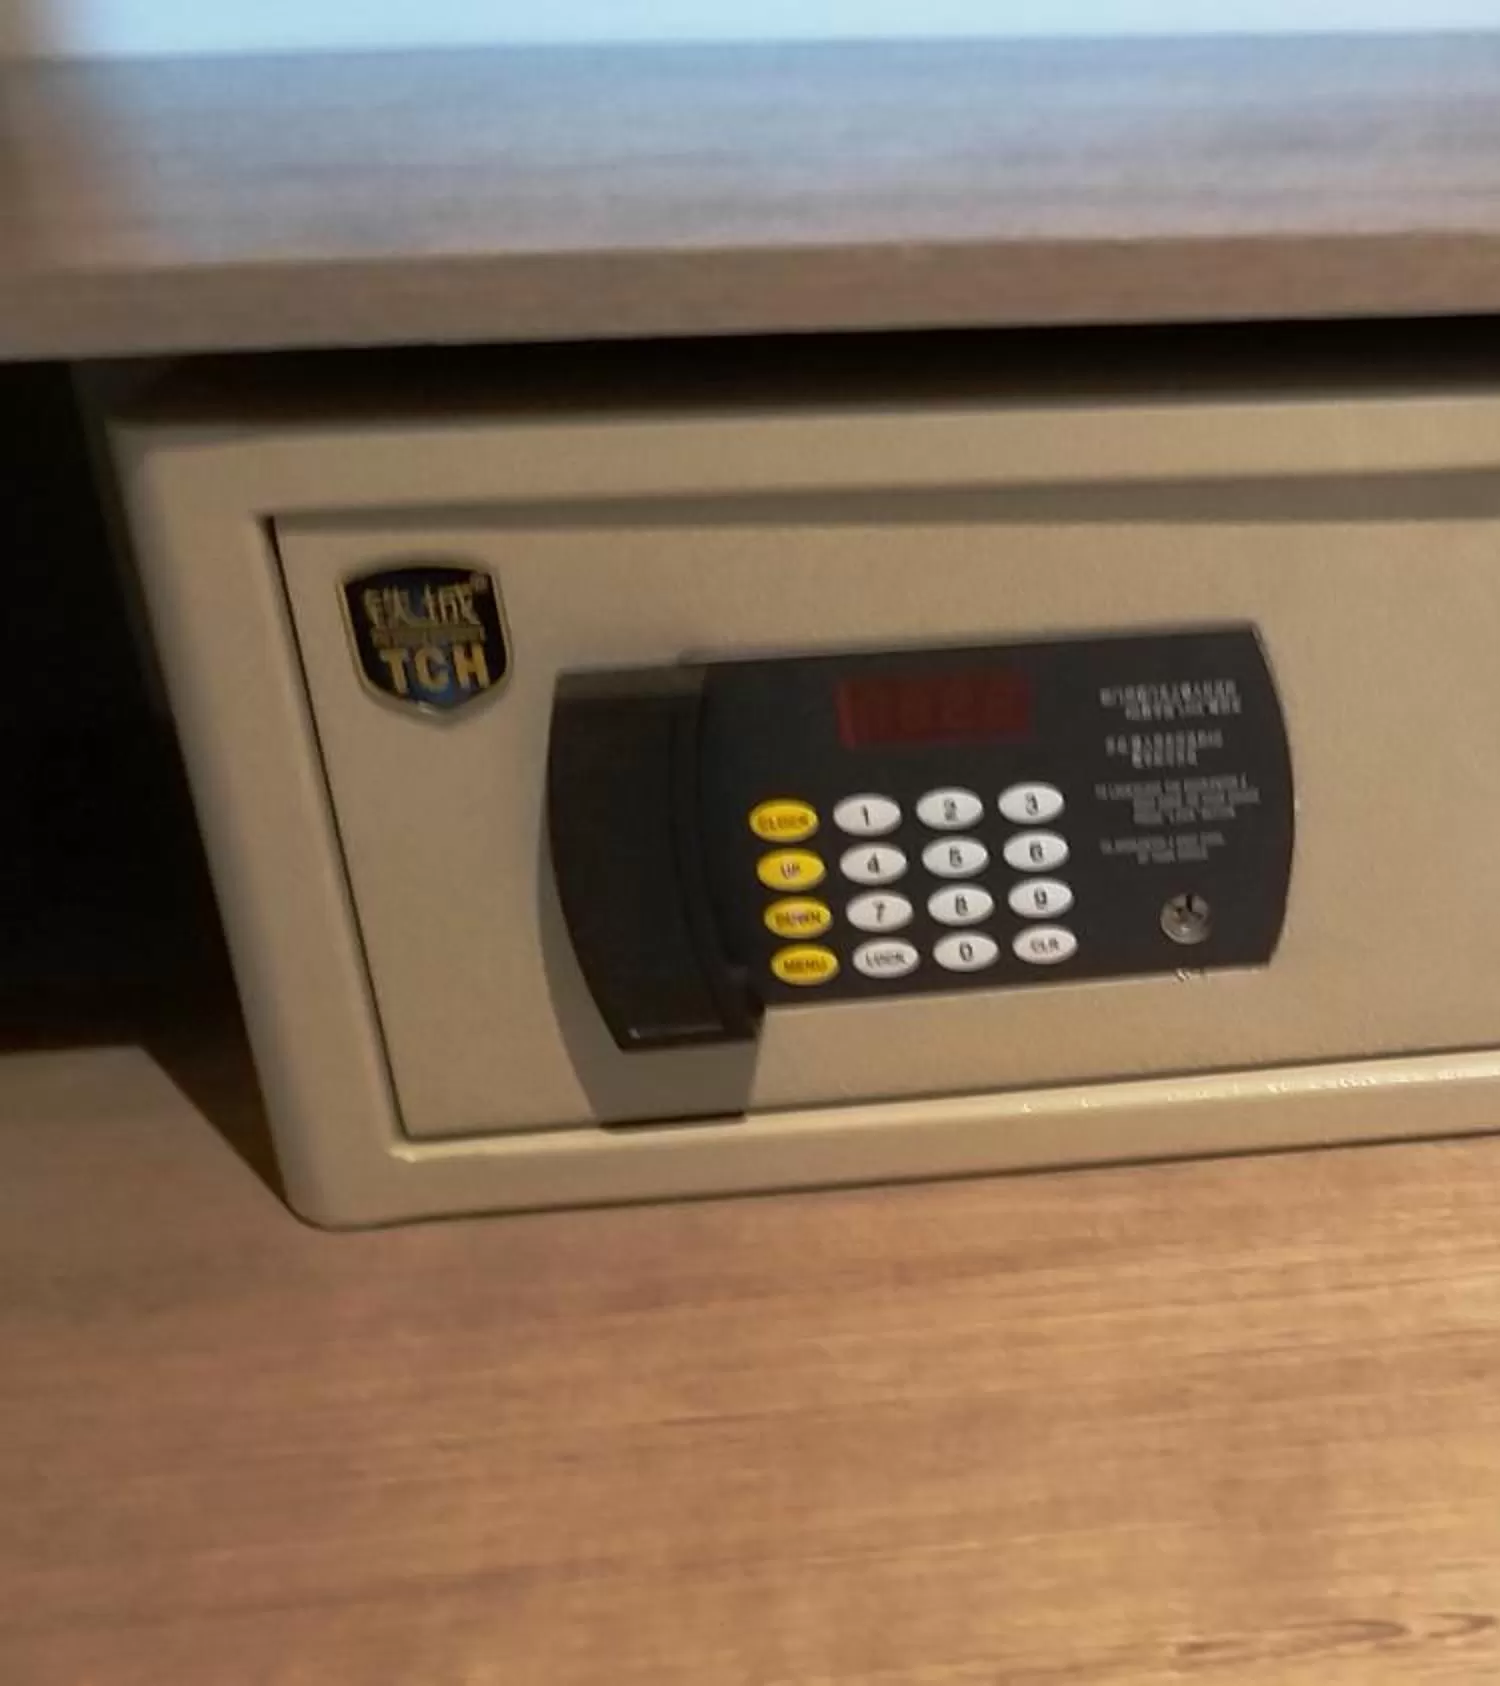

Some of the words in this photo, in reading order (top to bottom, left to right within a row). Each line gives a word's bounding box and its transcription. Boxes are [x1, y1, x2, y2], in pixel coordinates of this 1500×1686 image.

[380, 644, 489, 694] TCH
[860, 803, 871, 828] 1
[1024, 791, 1039, 817] 3
[866, 851, 880, 875] 4
[871, 900, 886, 924] 7
[958, 940, 973, 963] 0
